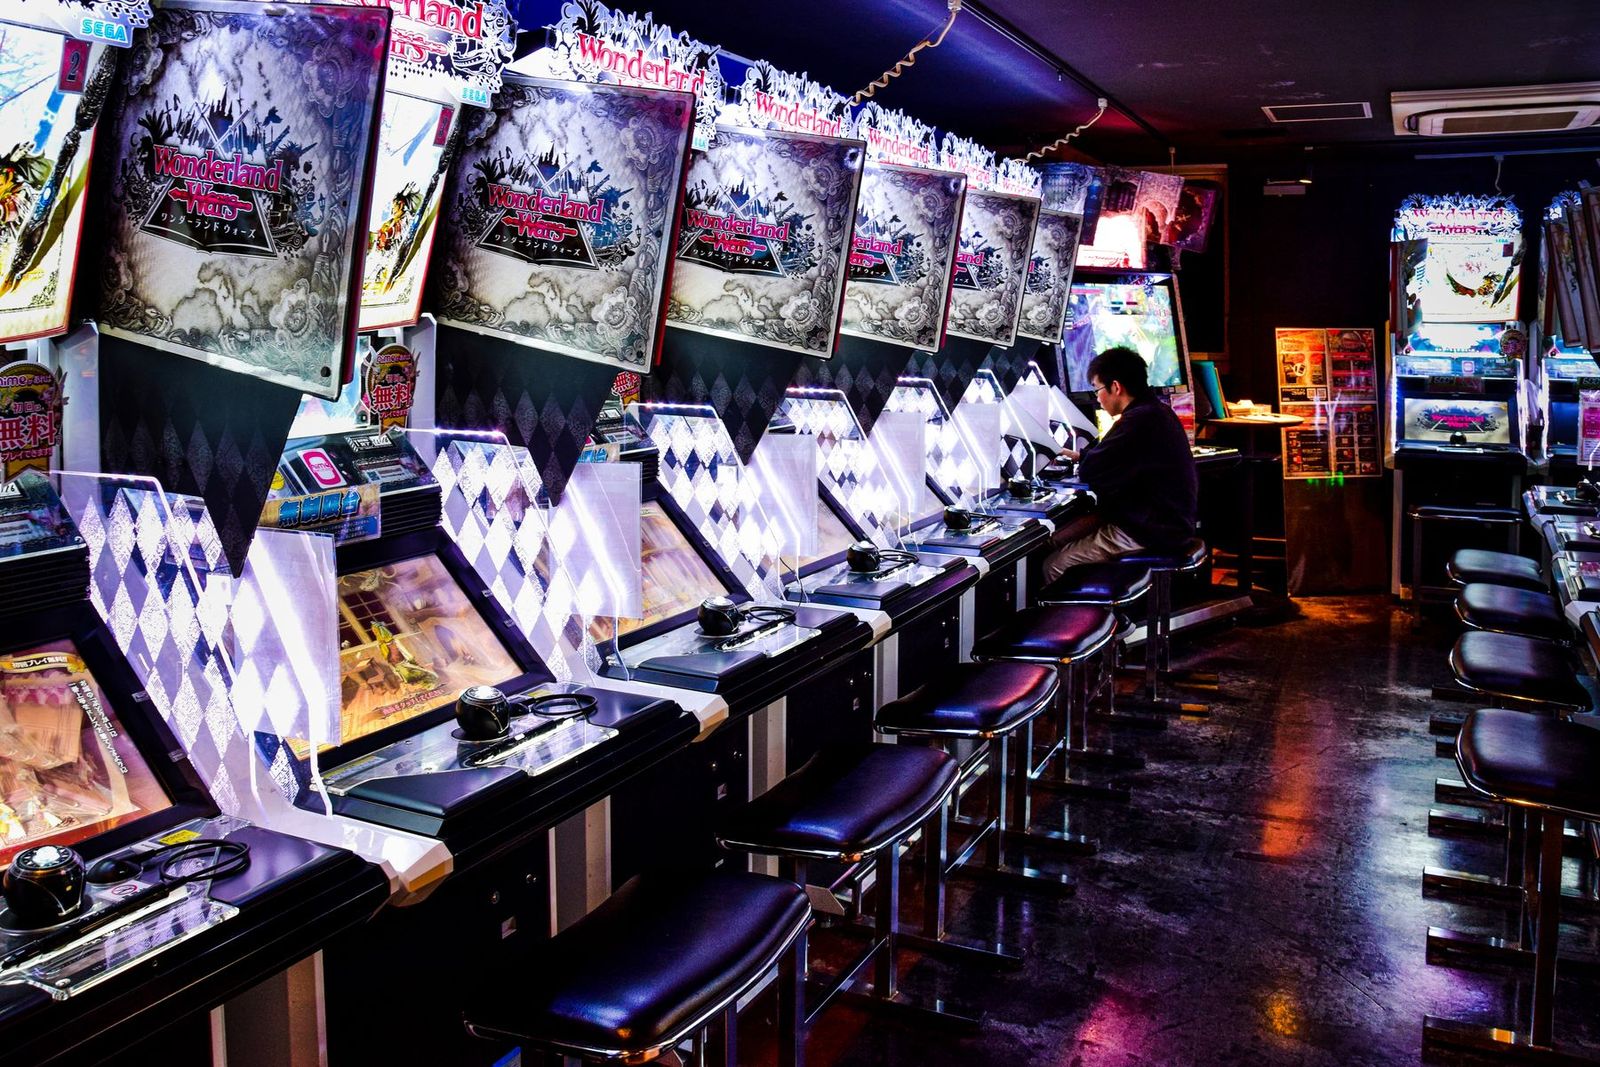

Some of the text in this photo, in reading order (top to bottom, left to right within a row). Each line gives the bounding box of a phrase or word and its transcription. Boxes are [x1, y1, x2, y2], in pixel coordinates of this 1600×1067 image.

[81, 18, 127, 42] SEGA
[66, 50, 81, 81] 2
[577, 32, 705, 98] Wonderland
[462, 87, 487, 104] SEGA
[756, 91, 842, 137] Wonderland
[868, 127, 929, 163] Wonderland
[153, 144, 283, 193] Wonderland
[184, 180, 239, 220] Wars
[488, 183, 604, 224] Wonderland
[516, 210, 565, 242] Wars
[686, 208, 791, 241] Wonderland
[713, 230, 756, 256] Wars
[852, 230, 903, 256] erland
[372, 382, 413, 412] 無料
[0, 411, 57, 451] 無料
